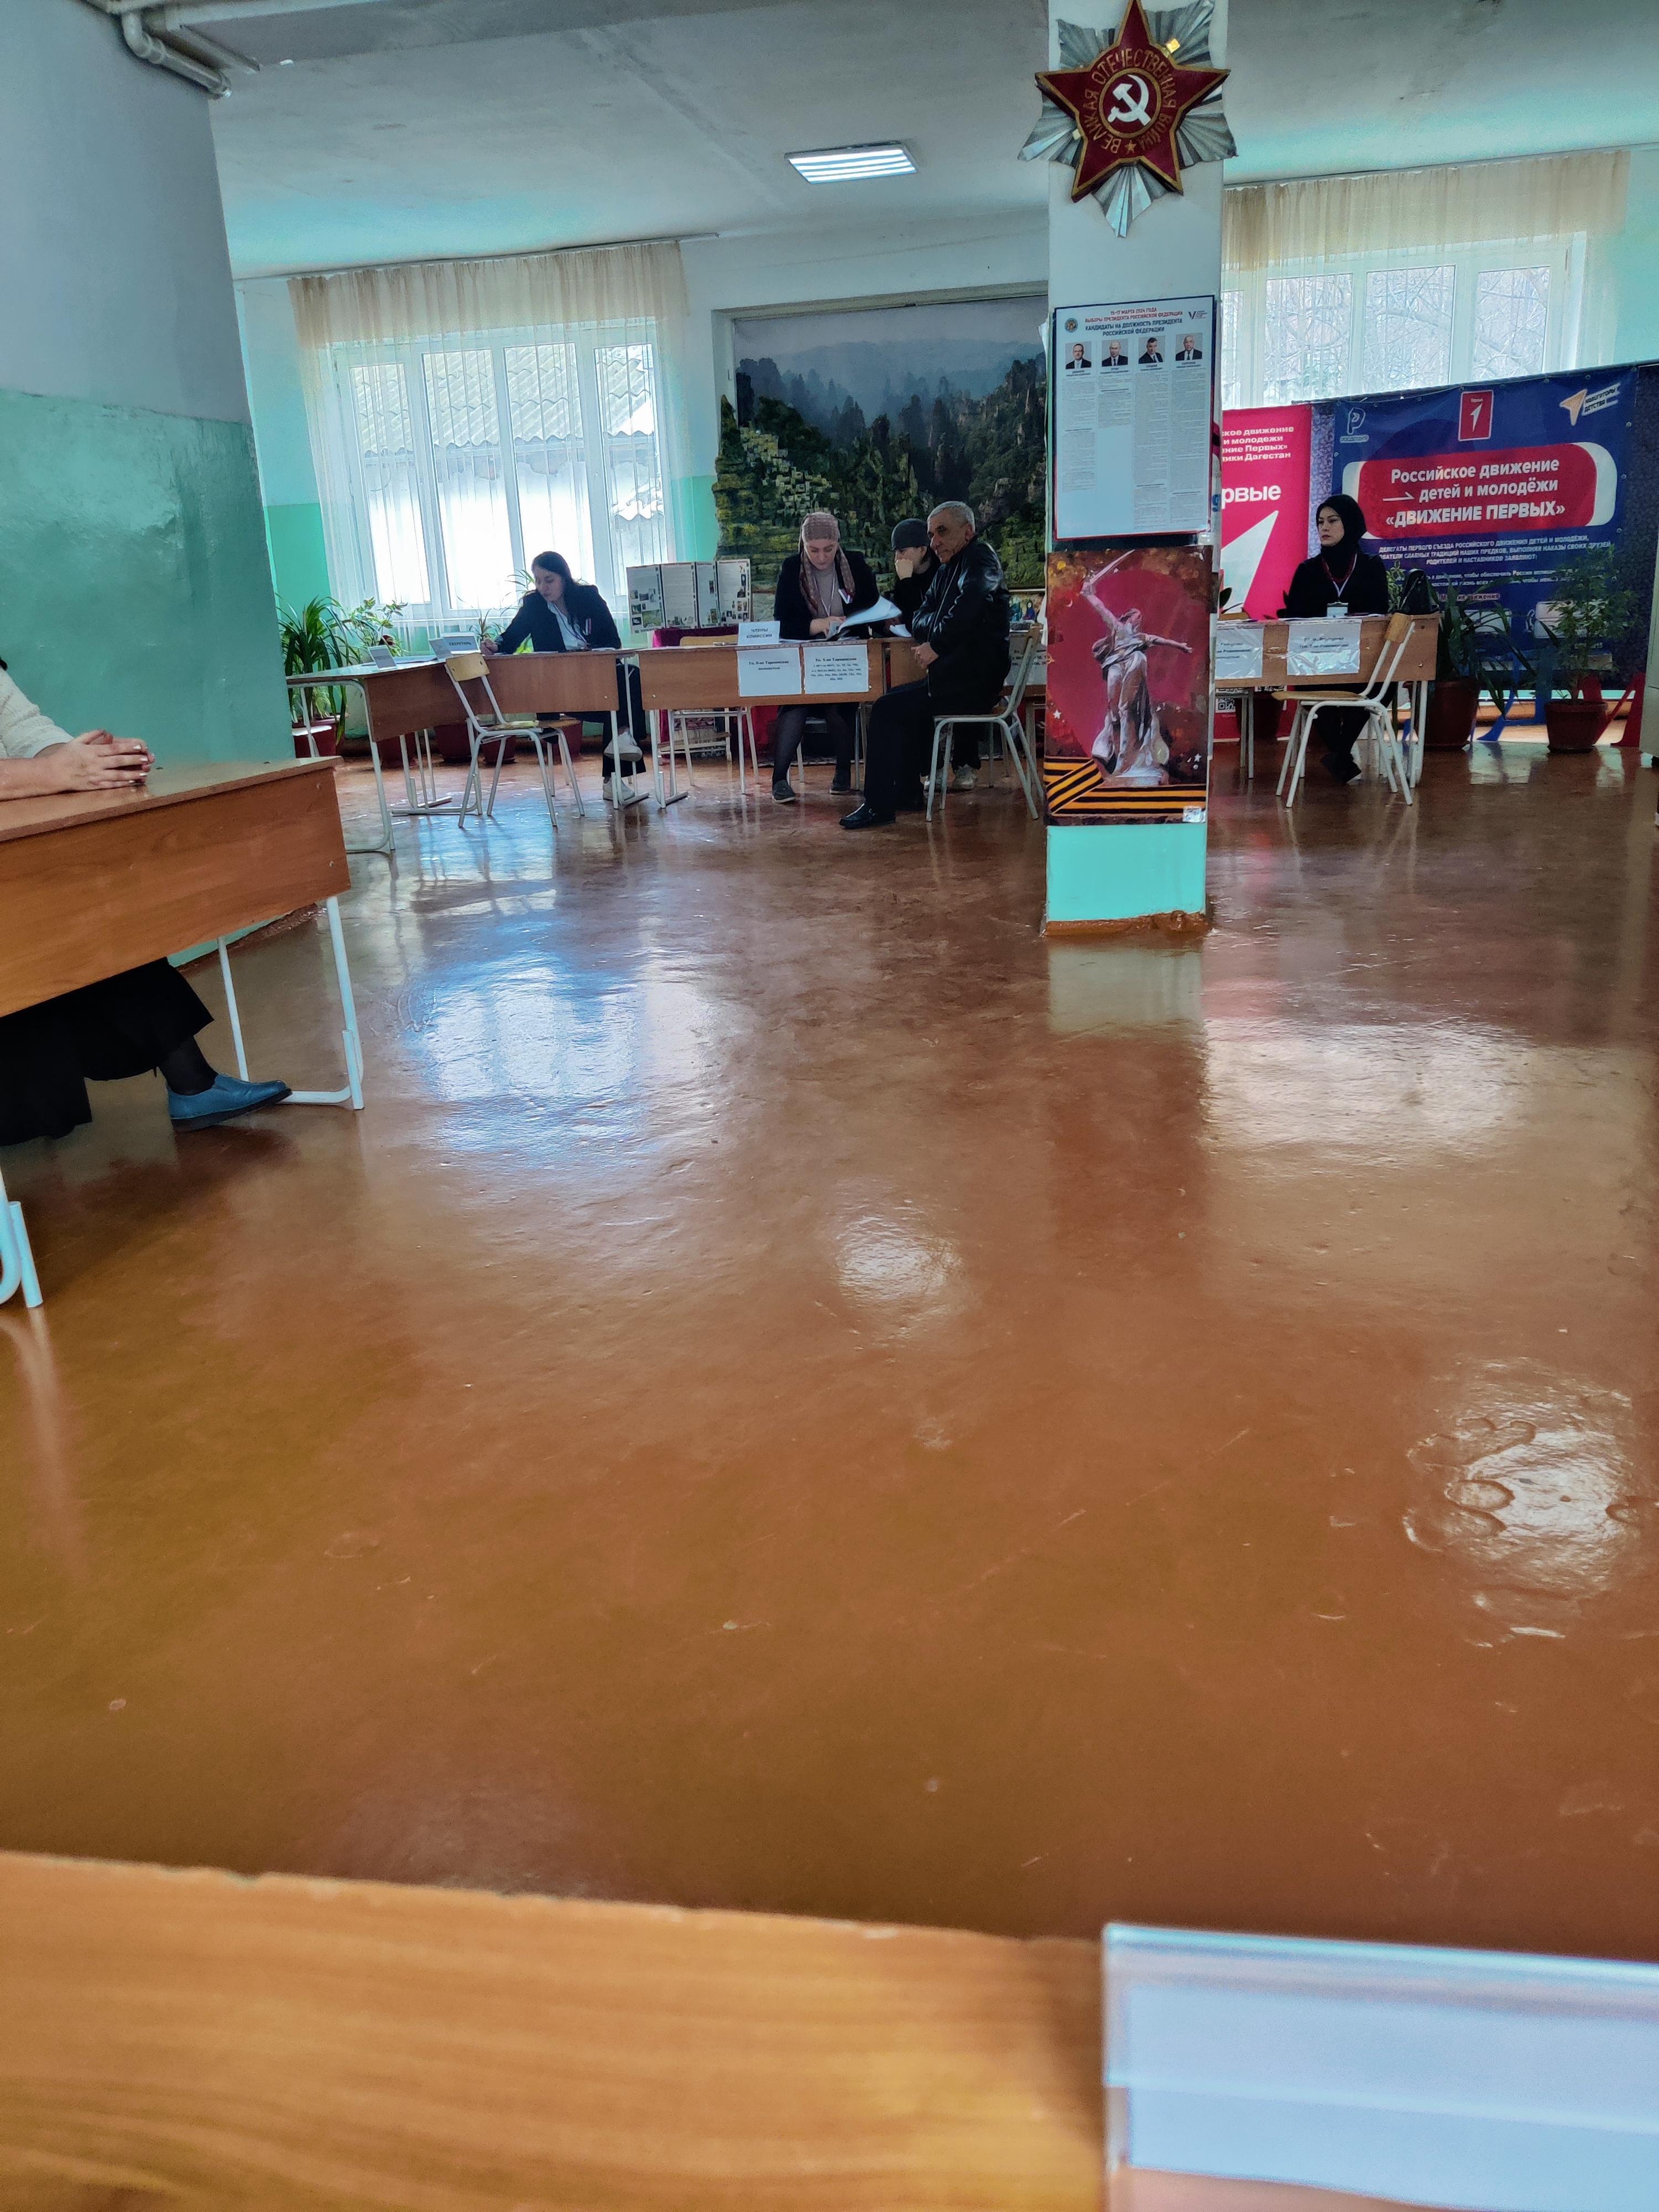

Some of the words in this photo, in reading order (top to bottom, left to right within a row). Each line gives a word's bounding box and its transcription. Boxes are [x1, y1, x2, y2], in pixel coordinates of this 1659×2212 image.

[1091, 48, 1177, 108] ОТЕЧЕСТВЕННАЯ
[1083, 88, 1121, 154] ВЕЛИКАЯ
[1138, 113, 1172, 150] ВОЙНА
[1232, 436, 1283, 445] молодежи
[1244, 426, 1294, 436] движение
[1245, 444, 1287, 452] Первых»
[1245, 452, 1291, 462] Дагестан
[1391, 466, 1475, 484] Российское
[1479, 458, 1560, 479] движение
[1419, 484, 1461, 503] детей
[1464, 486, 1473, 497] и
[1477, 477, 1558, 497] молодёжи
[1386, 505, 1482, 528] «ДВИЖЕНИЕ
[1485, 500, 1566, 520] ПЕРВЫХ»
[1528, 537, 1548, 545] ДЕТЕЙ
